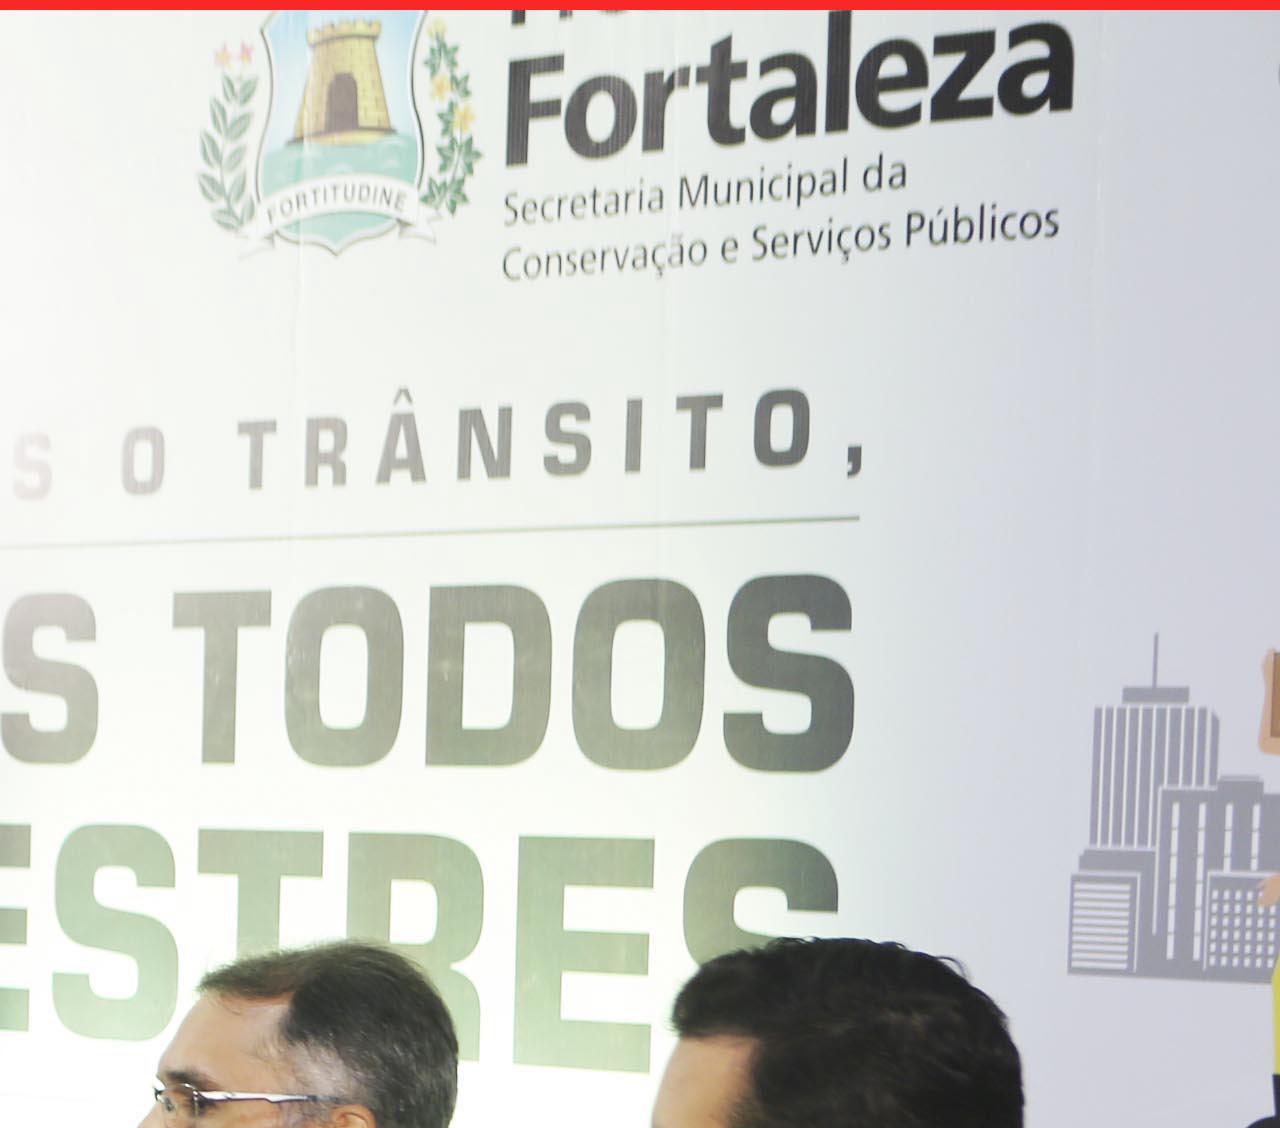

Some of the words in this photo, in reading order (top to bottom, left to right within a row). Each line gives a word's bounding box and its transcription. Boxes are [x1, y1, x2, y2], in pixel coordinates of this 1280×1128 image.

[504, 9, 1076, 168] Fortaleza
[266, 182, 408, 225] FORTITUDINE
[504, 177, 665, 227] Secretaria
[678, 157, 848, 210] Municipal
[862, 153, 907, 192] da
[502, 233, 708, 282] Conservação
[720, 235, 739, 264] e
[752, 217, 892, 265] Serviços
[905, 203, 1061, 248] Públicos
[121, 425, 166, 496] O
[237, 387, 865, 492] TRÂNSITO,
[171, 573, 856, 774] TODOS
